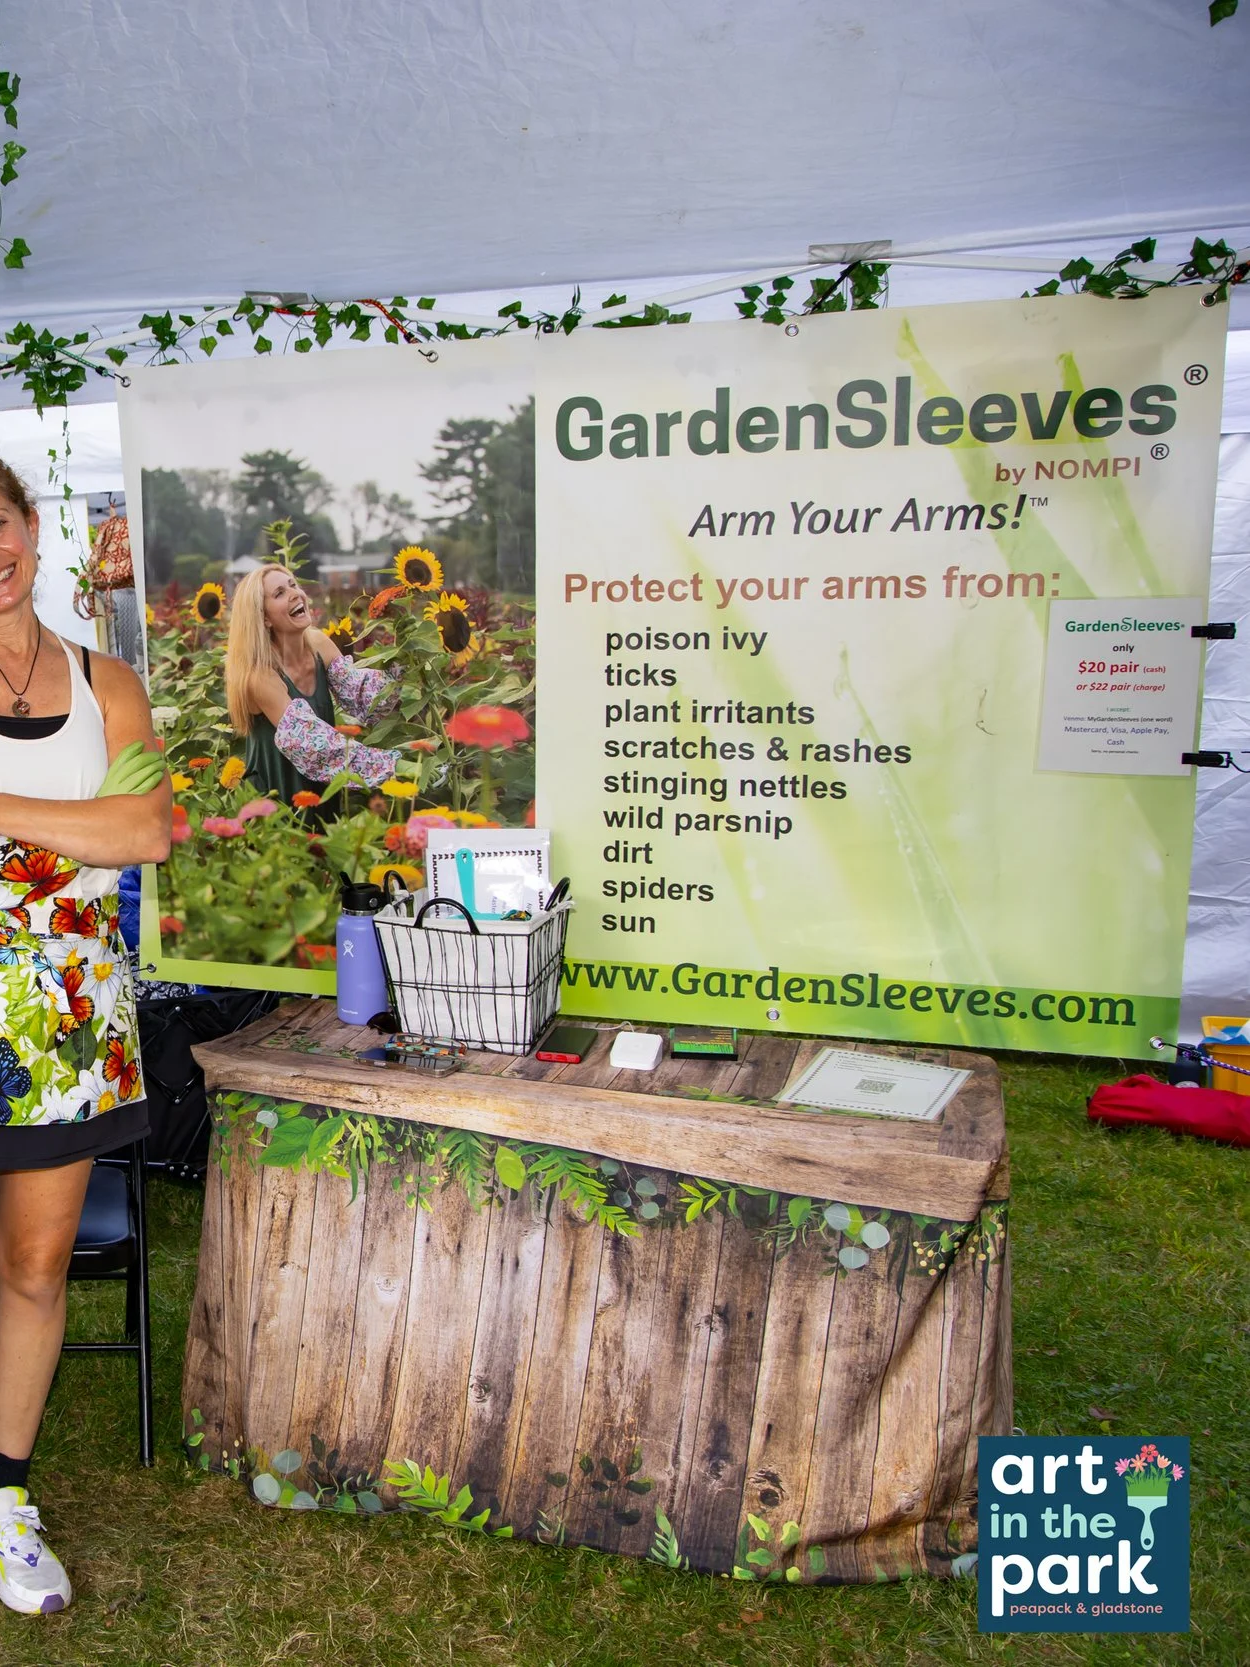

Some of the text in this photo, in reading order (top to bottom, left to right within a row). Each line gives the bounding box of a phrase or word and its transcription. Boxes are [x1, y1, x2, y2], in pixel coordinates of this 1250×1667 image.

[995, 461, 1026, 486] by
[689, 504, 775, 538] Arm
[791, 501, 881, 534] Your
[564, 567, 1061, 609] Protect your arms from:
[605, 626, 768, 657] poison ivy
[1112, 644, 1134, 653] only
[604, 661, 677, 688] ticks
[1078, 660, 1105, 675] $20
[1110, 661, 1139, 675] pair
[1090, 682, 1108, 692] $22
[1110, 683, 1130, 692] pair
[1133, 684, 1165, 692] (charge)
[604, 699, 815, 728] plant irritants
[1064, 726, 1108, 734] Mastercard,
[1130, 727, 1152, 735] Apple
[604, 736, 912, 765] scratches & rashes
[603, 771, 847, 801] stinging nettles
[603, 806, 793, 838] wild parsnip
[603, 839, 653, 865] dirt
[602, 876, 714, 905] spiders
[602, 910, 656, 934] sun
